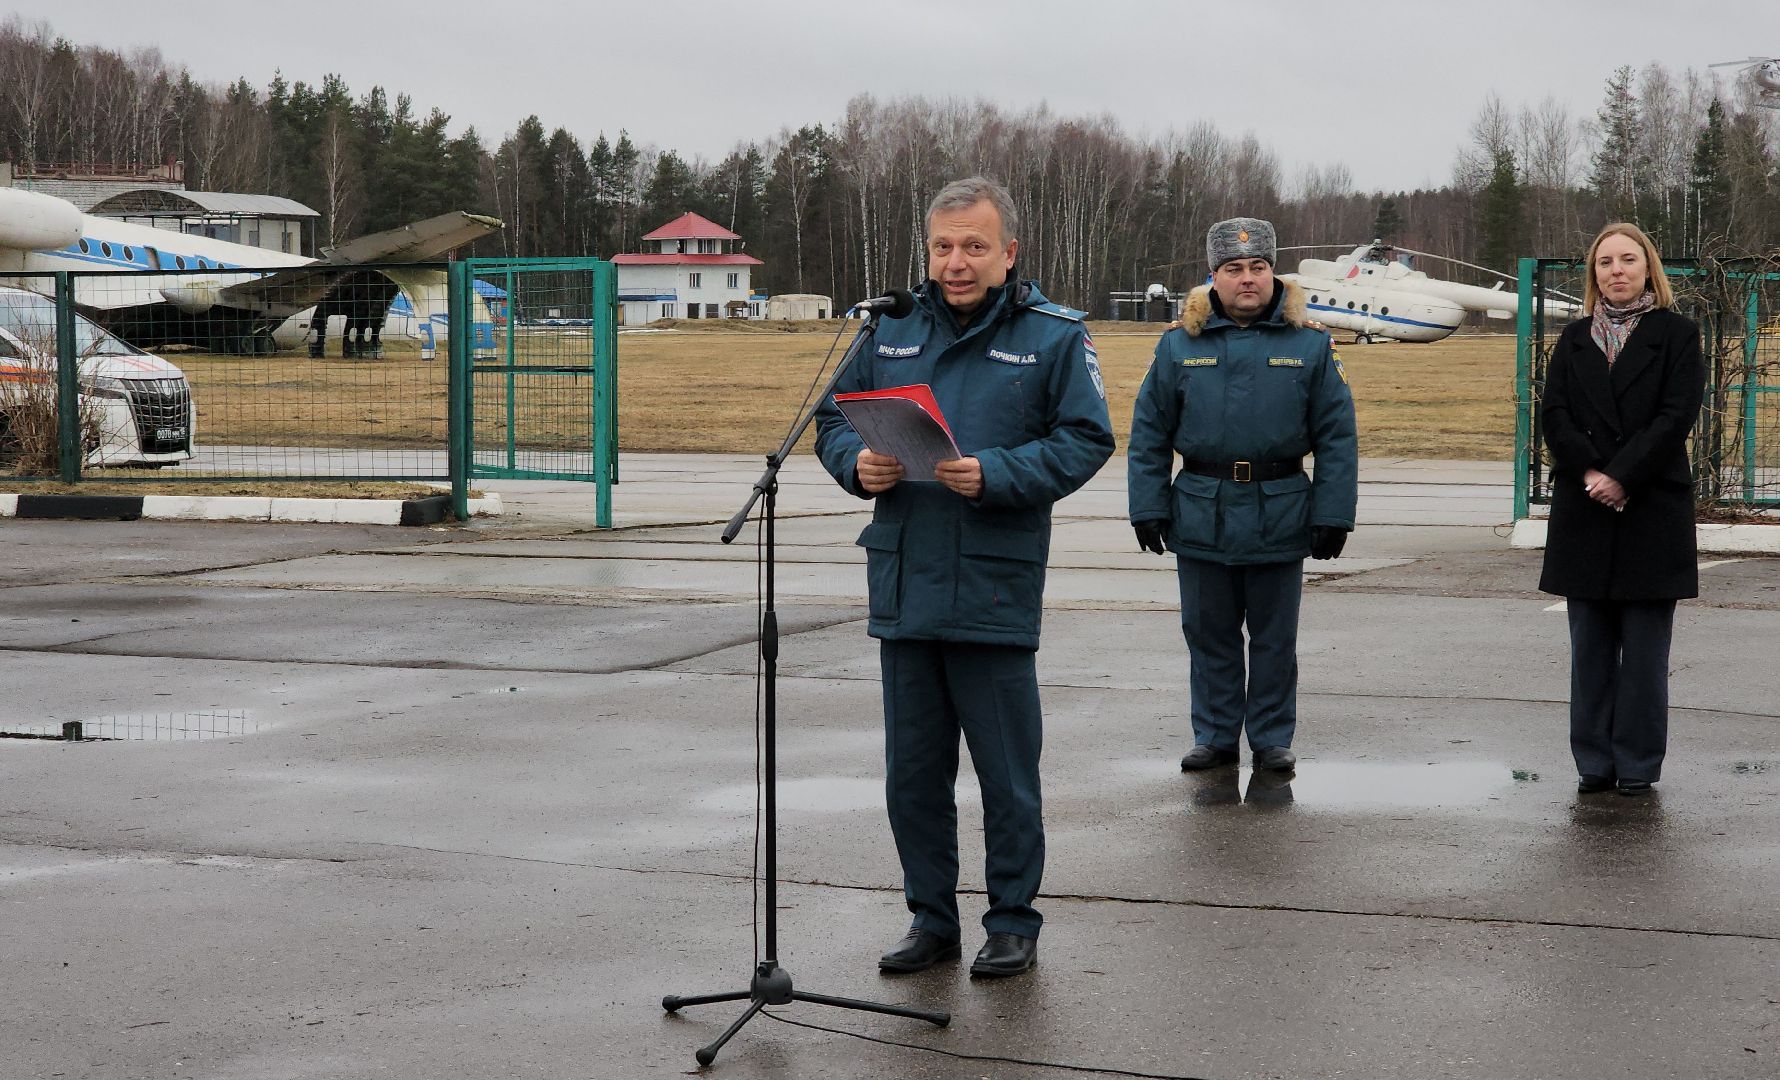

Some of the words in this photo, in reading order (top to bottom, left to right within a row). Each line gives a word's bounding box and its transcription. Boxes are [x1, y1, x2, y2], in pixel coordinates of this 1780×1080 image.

[878, 344, 895, 355] МЧС
[895, 345, 920, 356] РОССИИ
[990, 349, 1020, 363] ПОЧКИН
